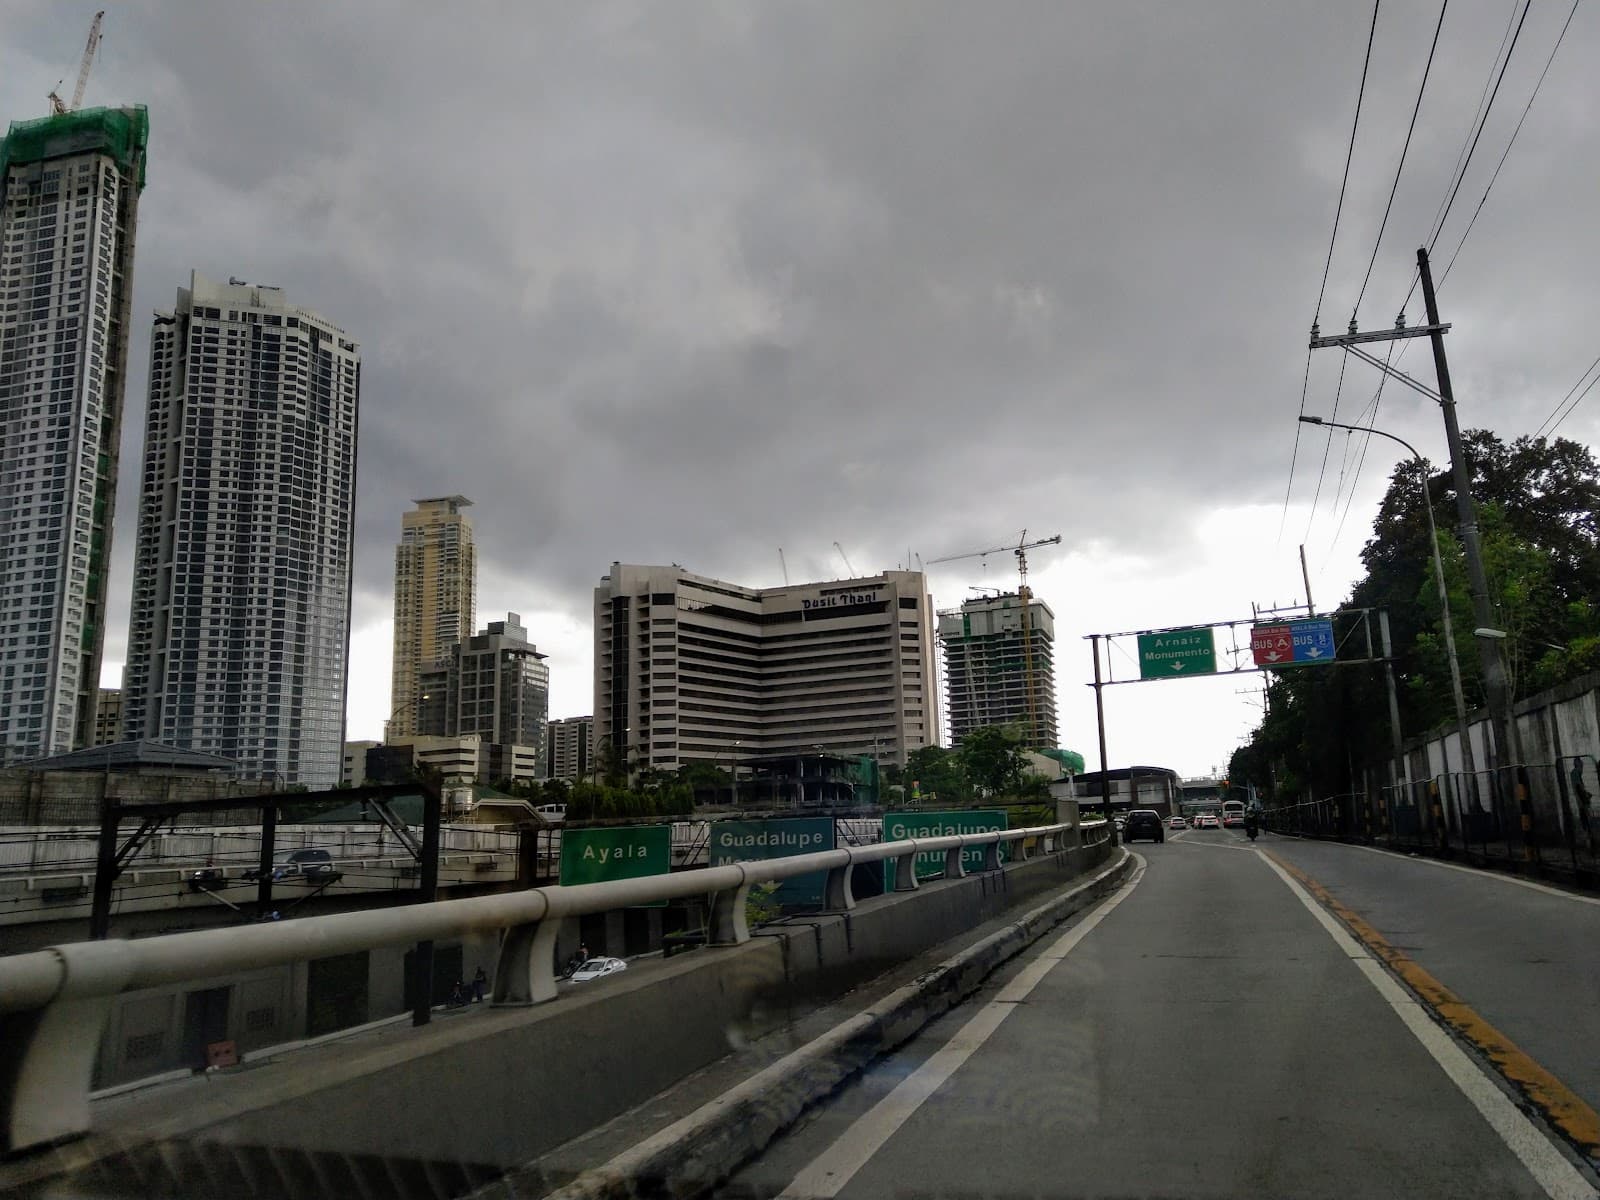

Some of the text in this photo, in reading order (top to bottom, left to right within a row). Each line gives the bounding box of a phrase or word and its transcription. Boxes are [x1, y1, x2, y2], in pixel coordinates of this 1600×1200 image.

[1155, 636, 1201, 648] Arnaiz
[1254, 639, 1273, 650] BUS
[1293, 635, 1313, 646] BUS
[1145, 647, 1210, 661] Monumento
[720, 831, 824, 849] Guadalupe
[583, 843, 648, 863] Ayala
